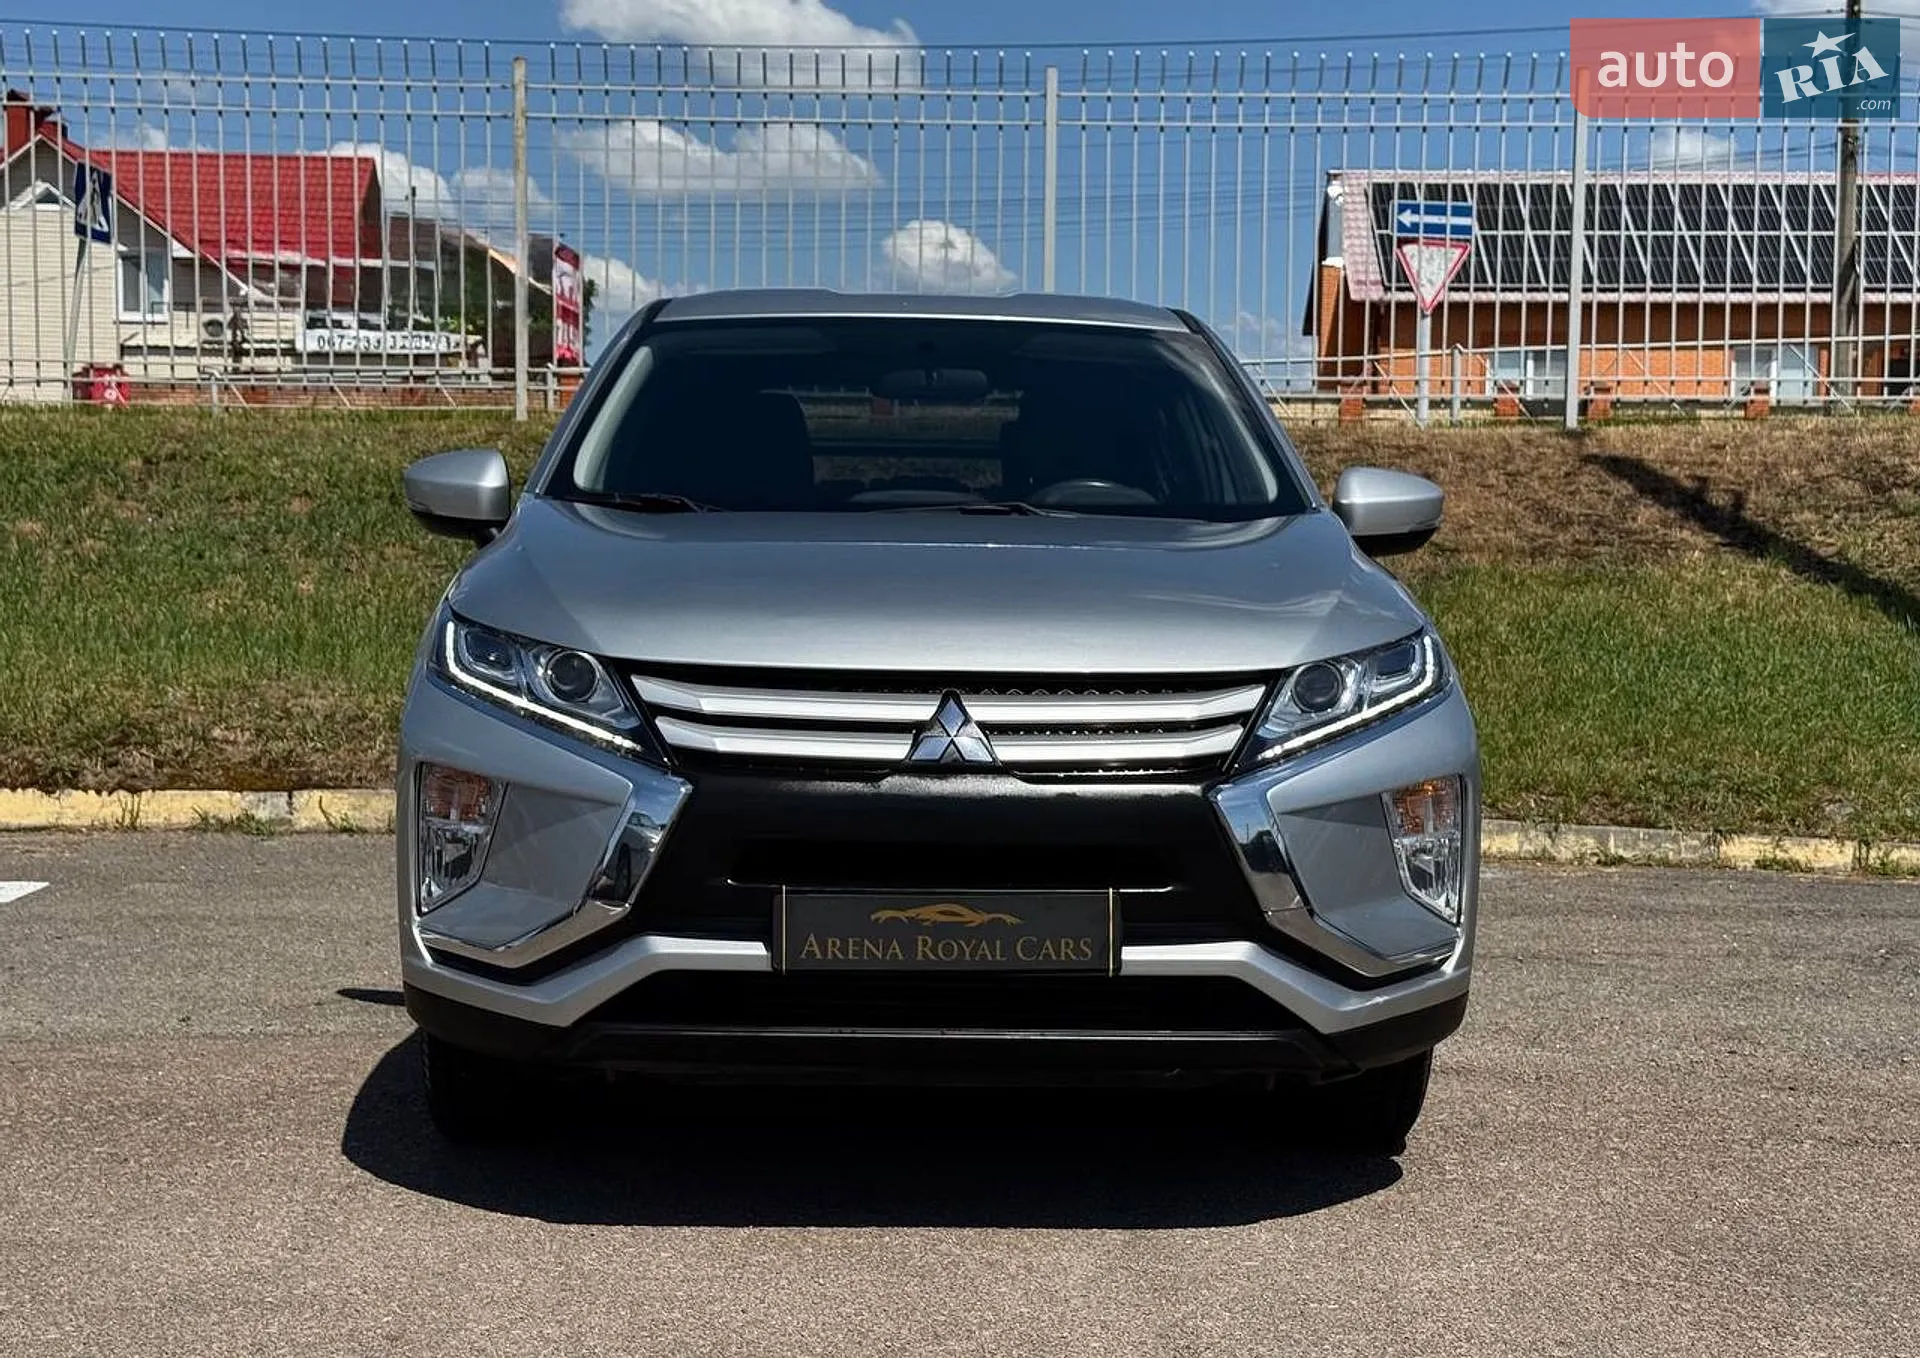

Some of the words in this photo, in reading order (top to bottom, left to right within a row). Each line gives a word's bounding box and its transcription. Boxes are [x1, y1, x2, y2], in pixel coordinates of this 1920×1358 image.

[800, 932, 904, 960] ARENA
[915, 935, 1010, 961] ROYAL
[1016, 936, 1092, 961] CARS
